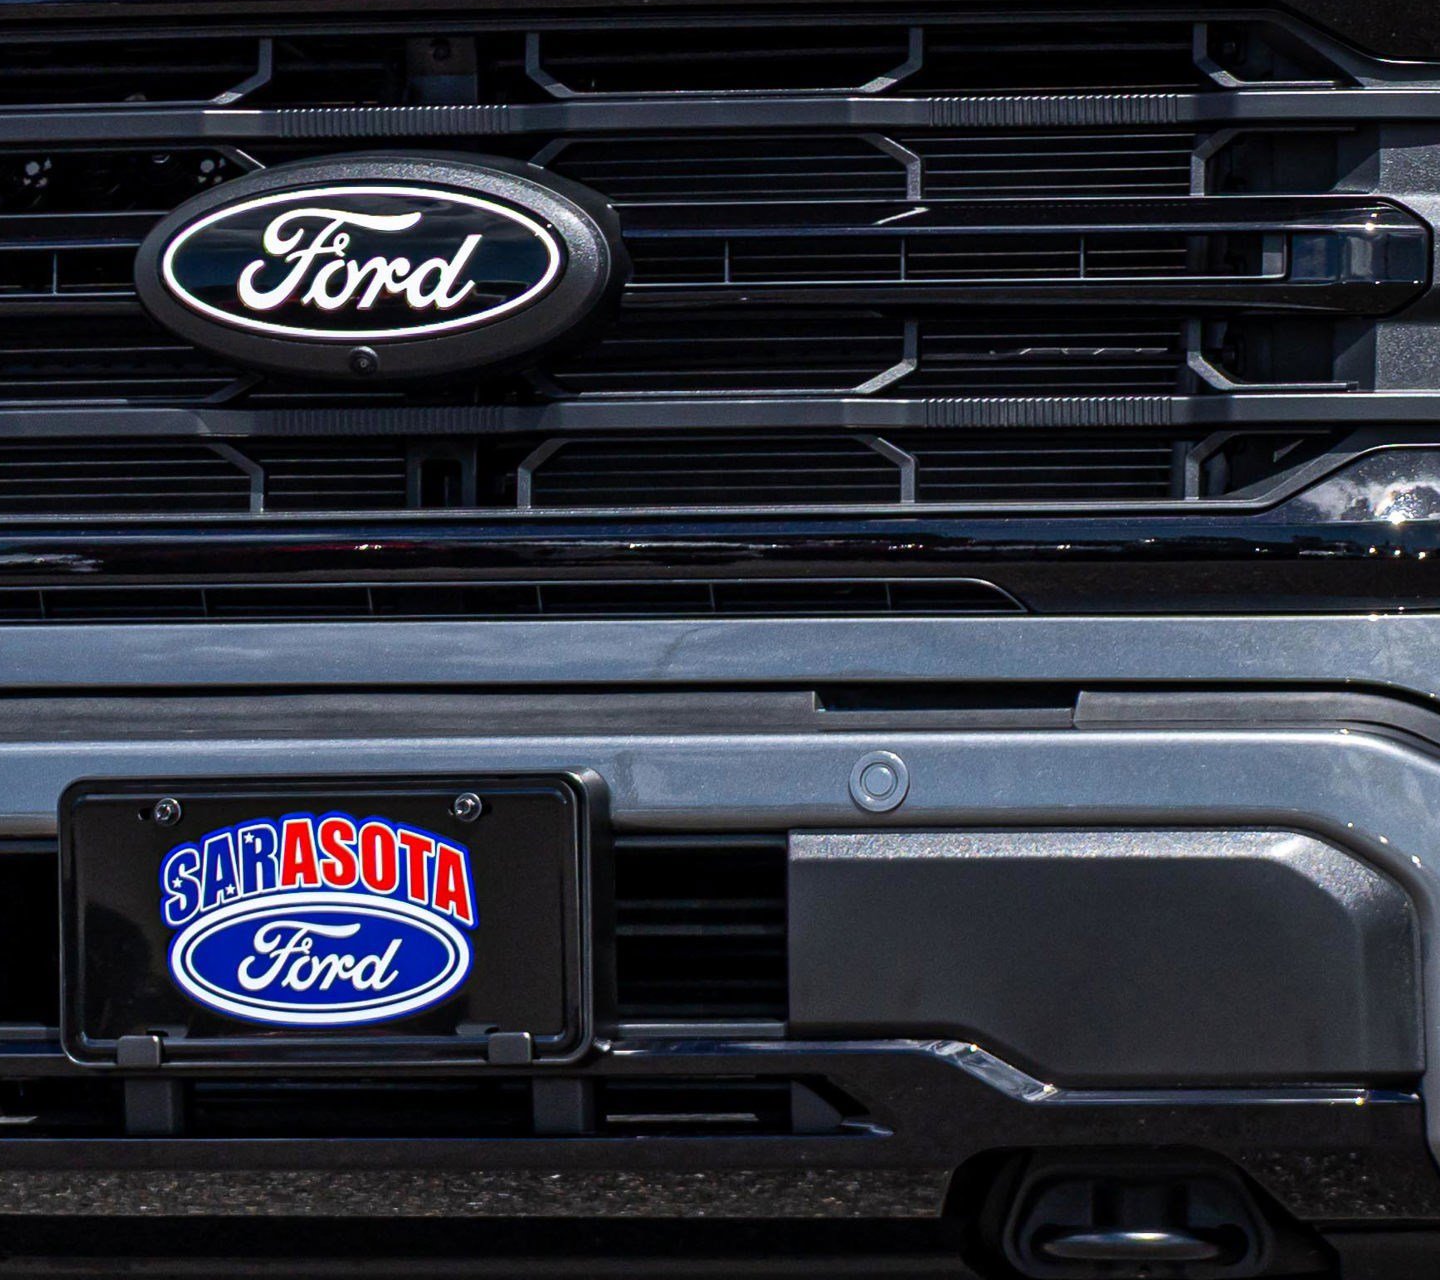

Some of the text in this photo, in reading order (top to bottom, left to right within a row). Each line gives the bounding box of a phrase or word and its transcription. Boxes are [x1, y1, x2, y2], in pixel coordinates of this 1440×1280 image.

[238, 207, 482, 311] Ford
[164, 817, 475, 926] SARASOTA
[237, 920, 403, 991] Ford
